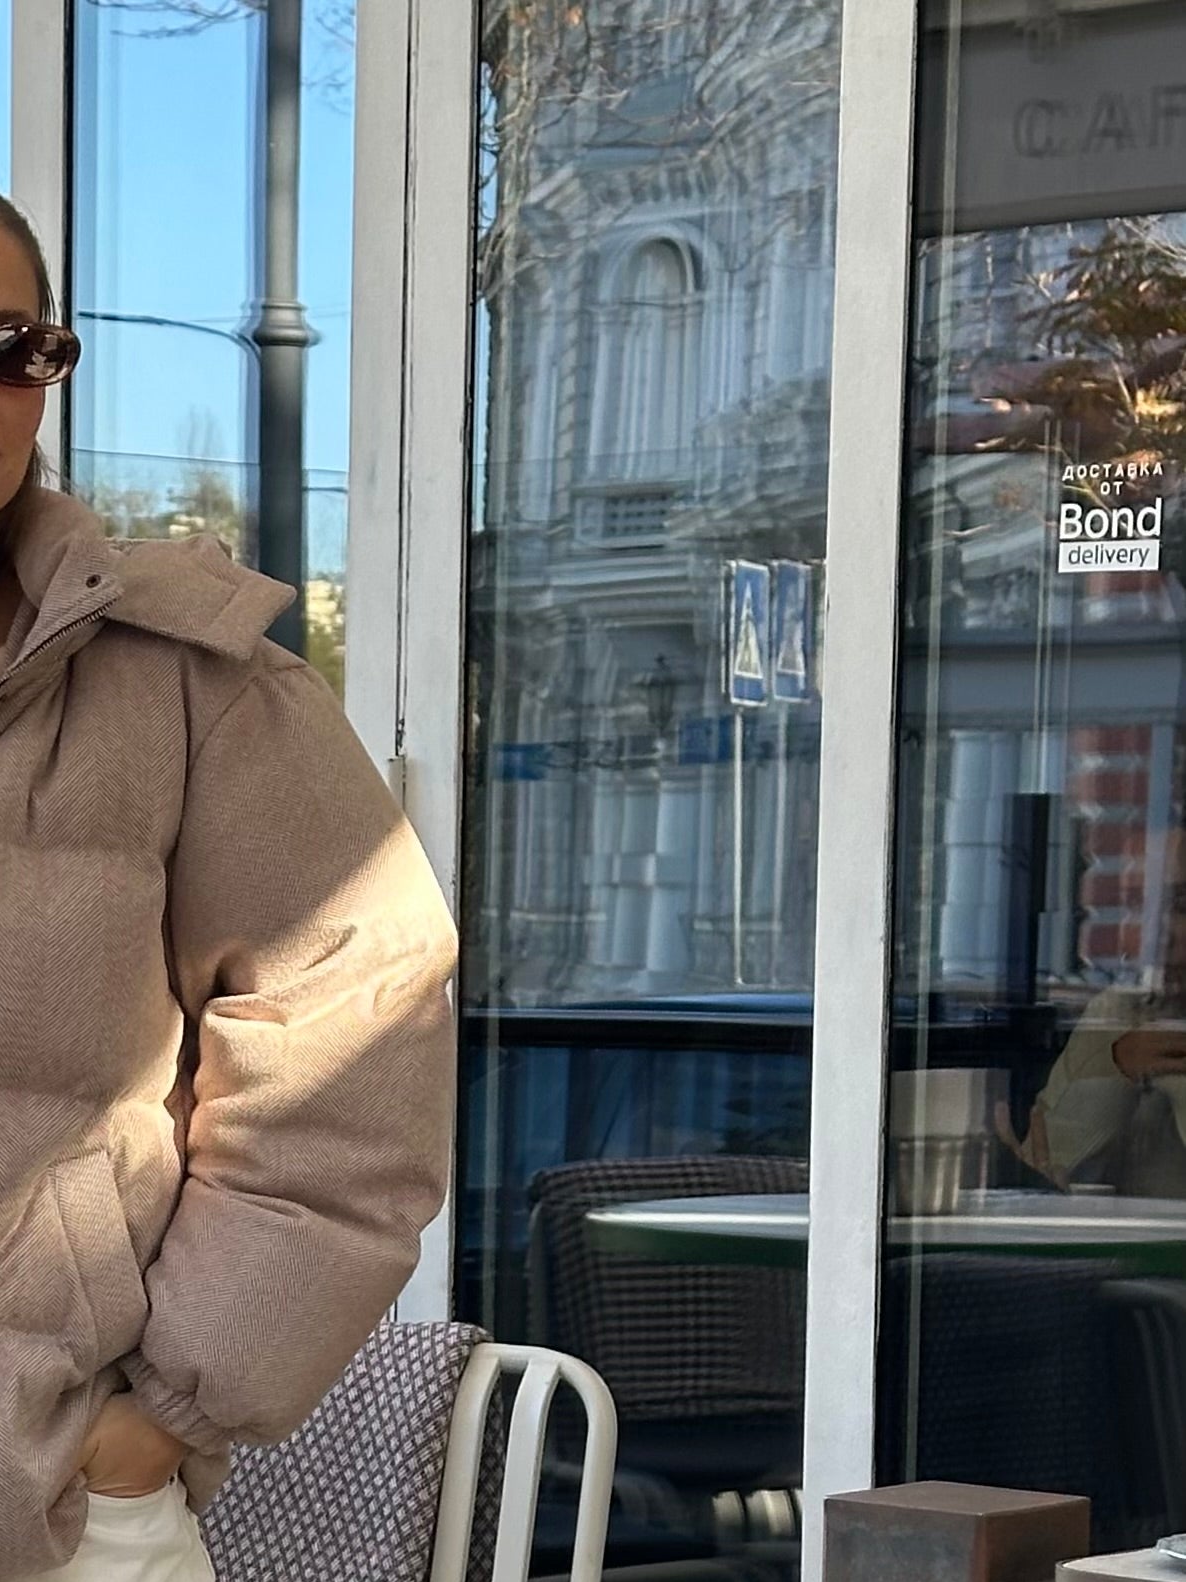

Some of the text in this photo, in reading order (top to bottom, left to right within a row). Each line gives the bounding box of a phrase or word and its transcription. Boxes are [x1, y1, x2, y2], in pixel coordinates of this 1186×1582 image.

[1061, 462, 1163, 481] ДОСТАВКА
[1100, 481, 1124, 495] ОТ
[1059, 497, 1163, 540] Bond
[1068, 543, 1150, 568] delivery
